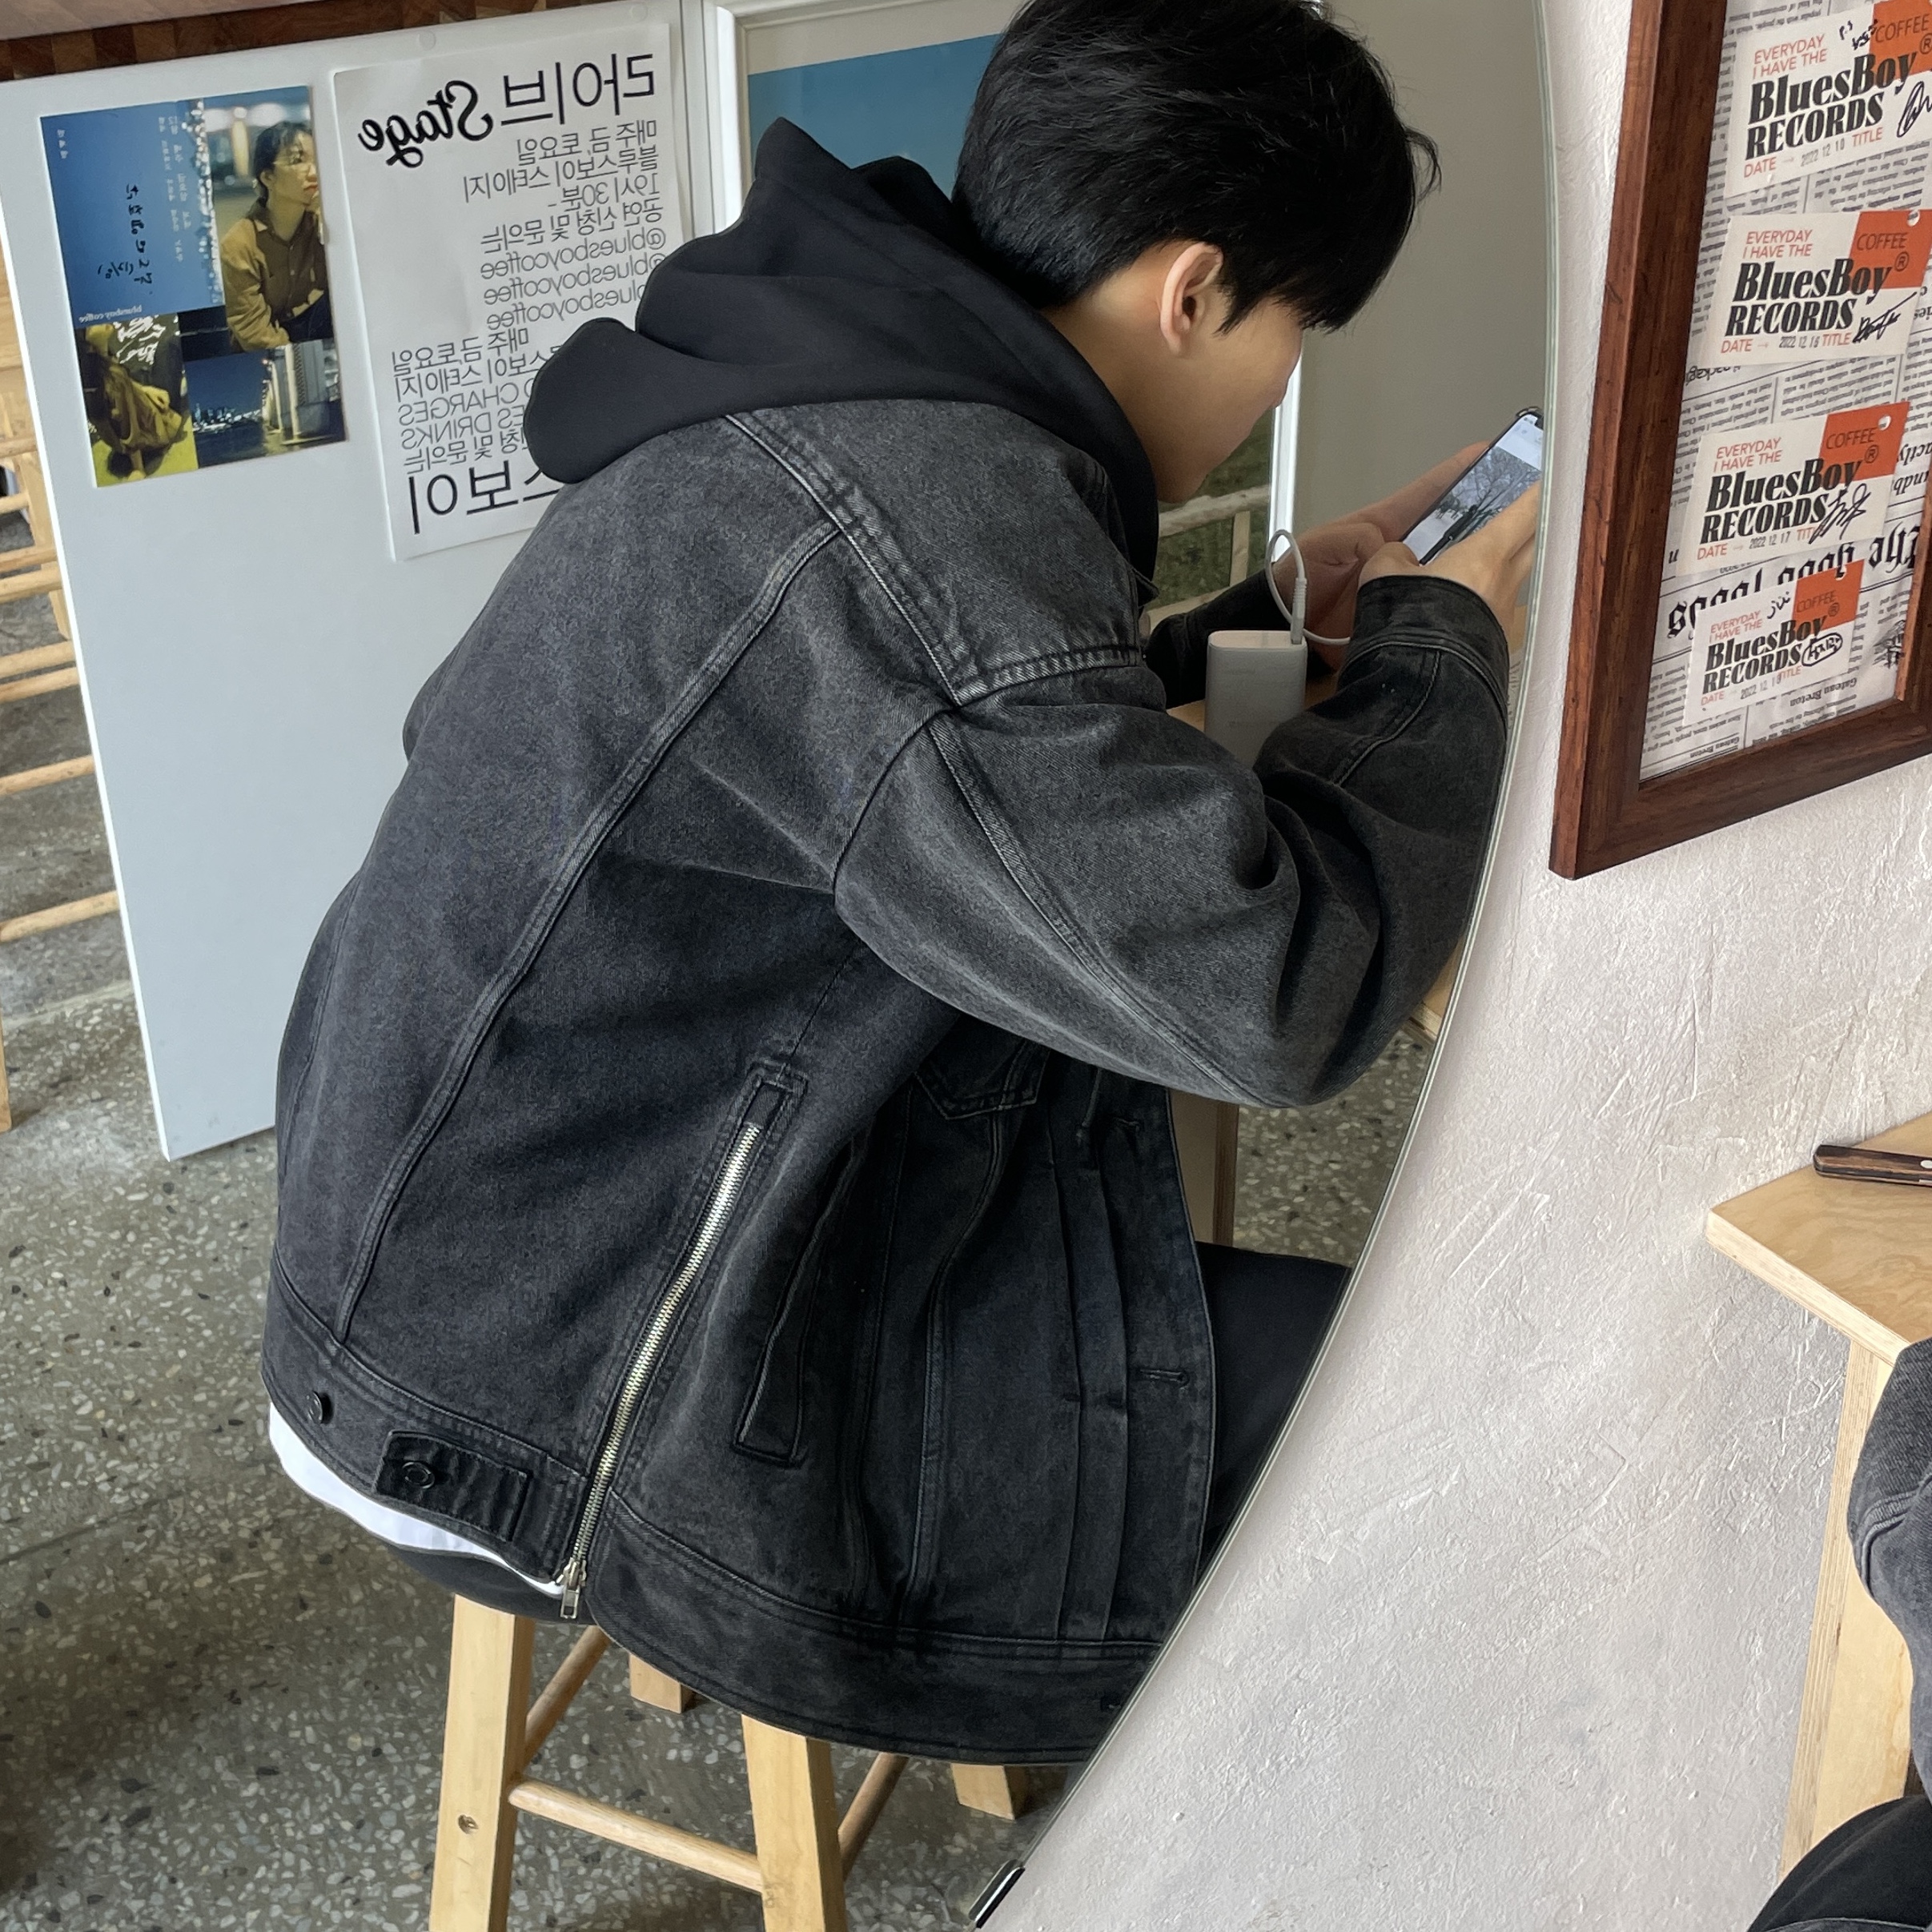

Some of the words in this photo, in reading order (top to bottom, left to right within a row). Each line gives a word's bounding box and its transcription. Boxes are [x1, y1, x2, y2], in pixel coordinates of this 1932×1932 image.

[1875, 14, 1930, 42] COFFEE
[1754, 34, 1826, 64] EVERYDAY
[1761, 55, 1797, 78] HAVE
[1802, 48, 1827, 66] THE
[1749, 51, 1918, 125] BluesBoy
[1745, 92, 1884, 160] RECORDS
[1744, 157, 1777, 178] DATE
[1852, 127, 1883, 147] TITLE
[1746, 229, 1813, 245] EVERYDAY
[1856, 232, 1908, 251] COFFEE
[1750, 244, 1785, 259] HAVE
[1789, 243, 1813, 257] THE
[1733, 258, 1893, 305] BluesBoy
[1725, 299, 1857, 336] RECORDS
[1721, 338, 1753, 353] DATE
[1822, 332, 1852, 346] TITLE
[1717, 436, 1781, 459] EVERYDAY
[1826, 427, 1878, 449] COFFEE
[1721, 455, 1754, 471] HAVE
[1758, 449, 1783, 465] THE
[1705, 458, 1863, 512] BluesBoy
[1700, 493, 1830, 544] RECORDS
[1697, 543, 1728, 560] DATE
[1796, 589, 1837, 613] COFFEE
[1710, 610, 1761, 633] EVERYDAY
[1716, 626, 1741, 641] HAVE
[1744, 620, 1763, 632] THE
[1705, 615, 1827, 672] BluesBoy
[1702, 643, 1803, 694] RECORDS
[1701, 690, 1725, 705] DATE
